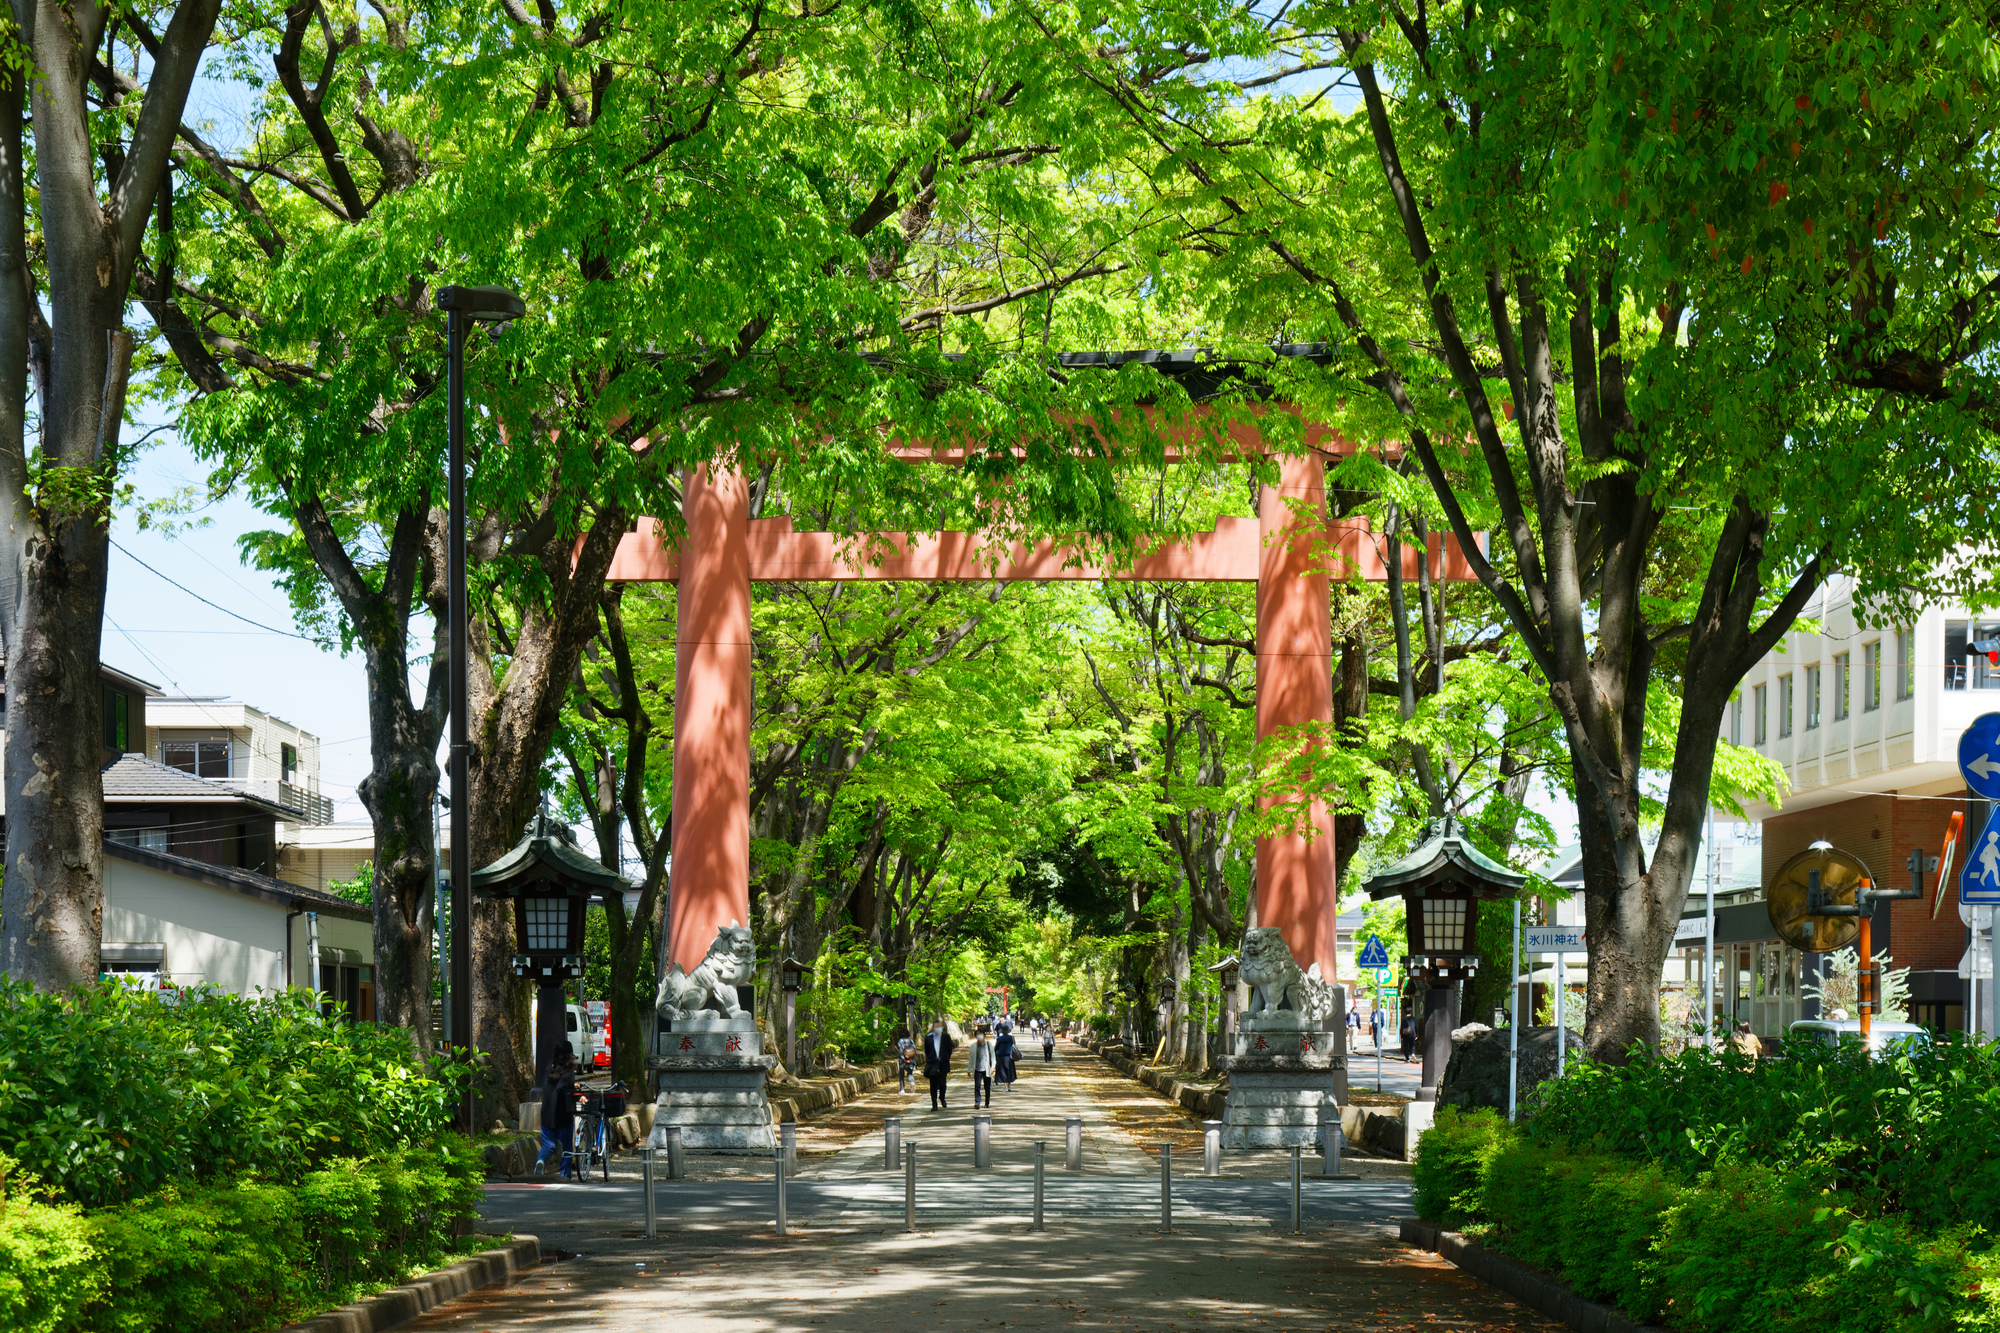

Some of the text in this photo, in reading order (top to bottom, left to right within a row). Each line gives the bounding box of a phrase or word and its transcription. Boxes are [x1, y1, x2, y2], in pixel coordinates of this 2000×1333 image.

[1528, 933, 1579, 946] 氷川神社
[1380, 969, 1390, 983] P
